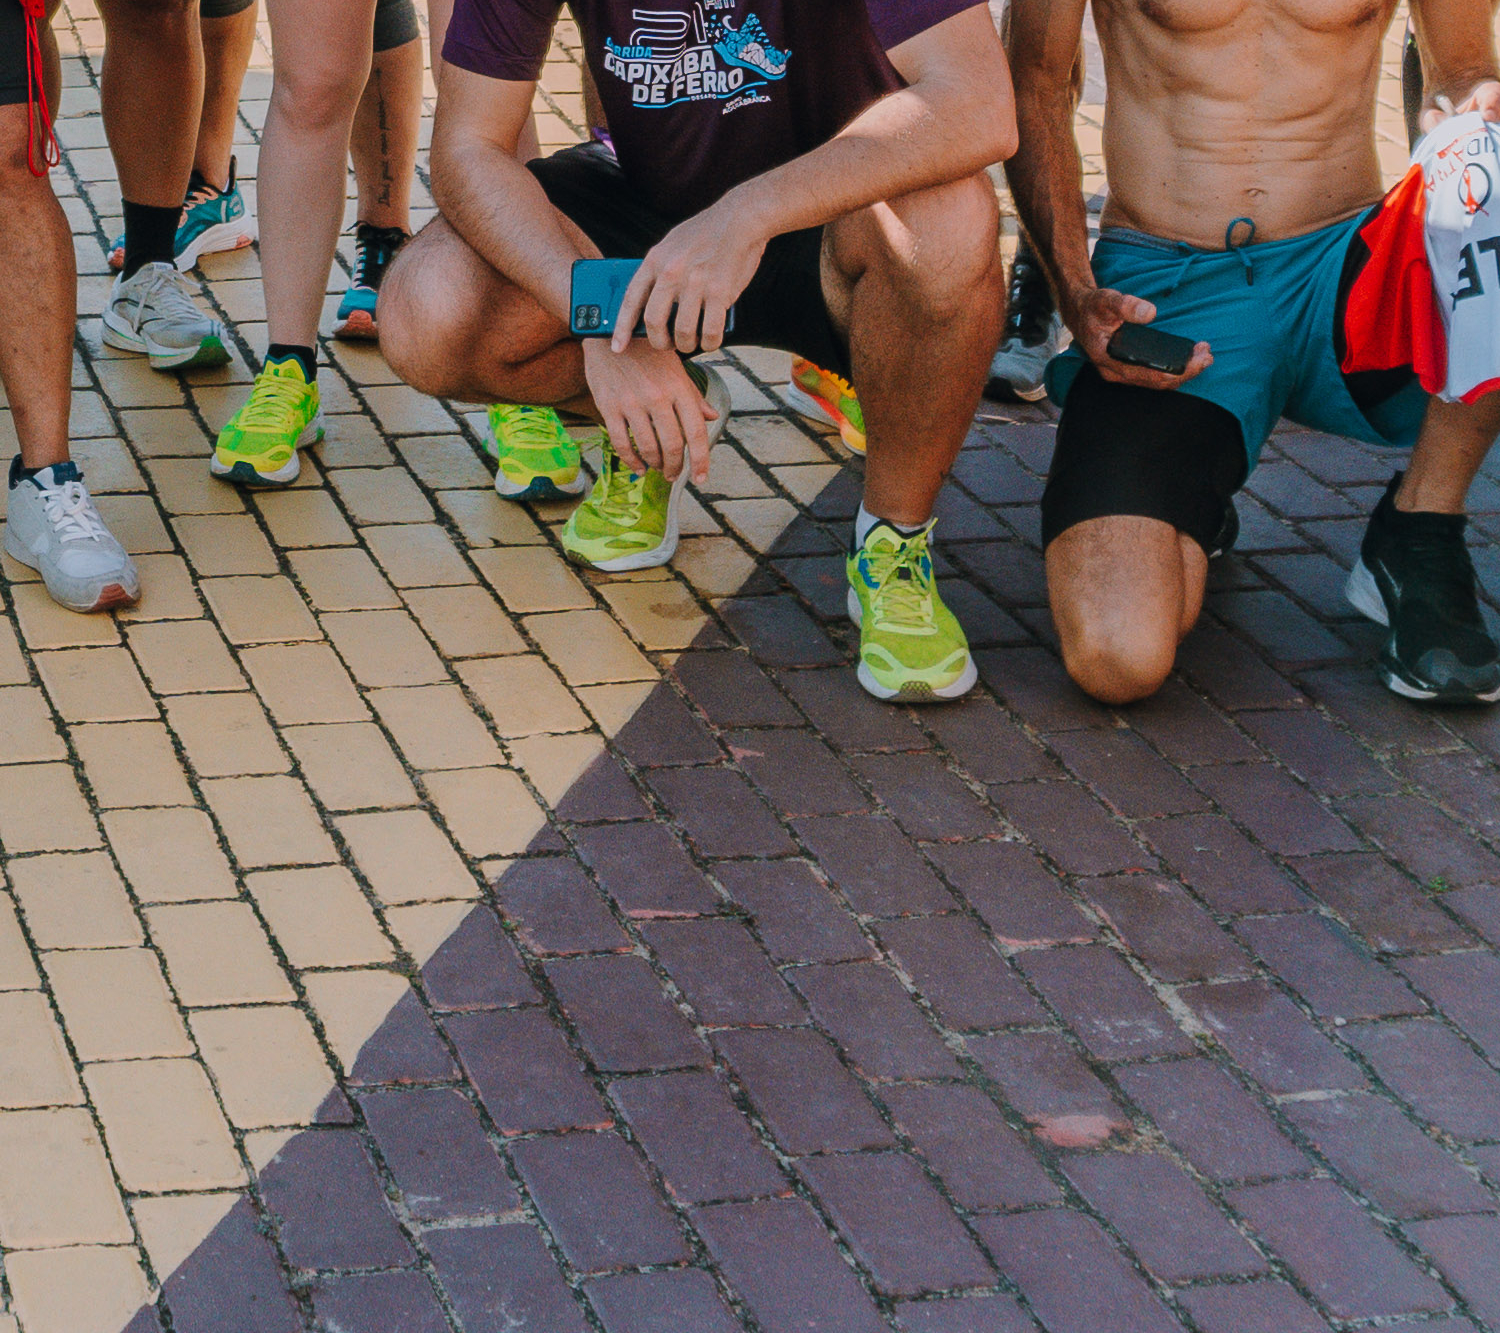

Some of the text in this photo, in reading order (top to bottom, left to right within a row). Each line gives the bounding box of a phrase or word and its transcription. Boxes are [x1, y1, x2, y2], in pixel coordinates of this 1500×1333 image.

[604, 50, 716, 84] CAPIXABA
[632, 68, 744, 103] DE FERRO
